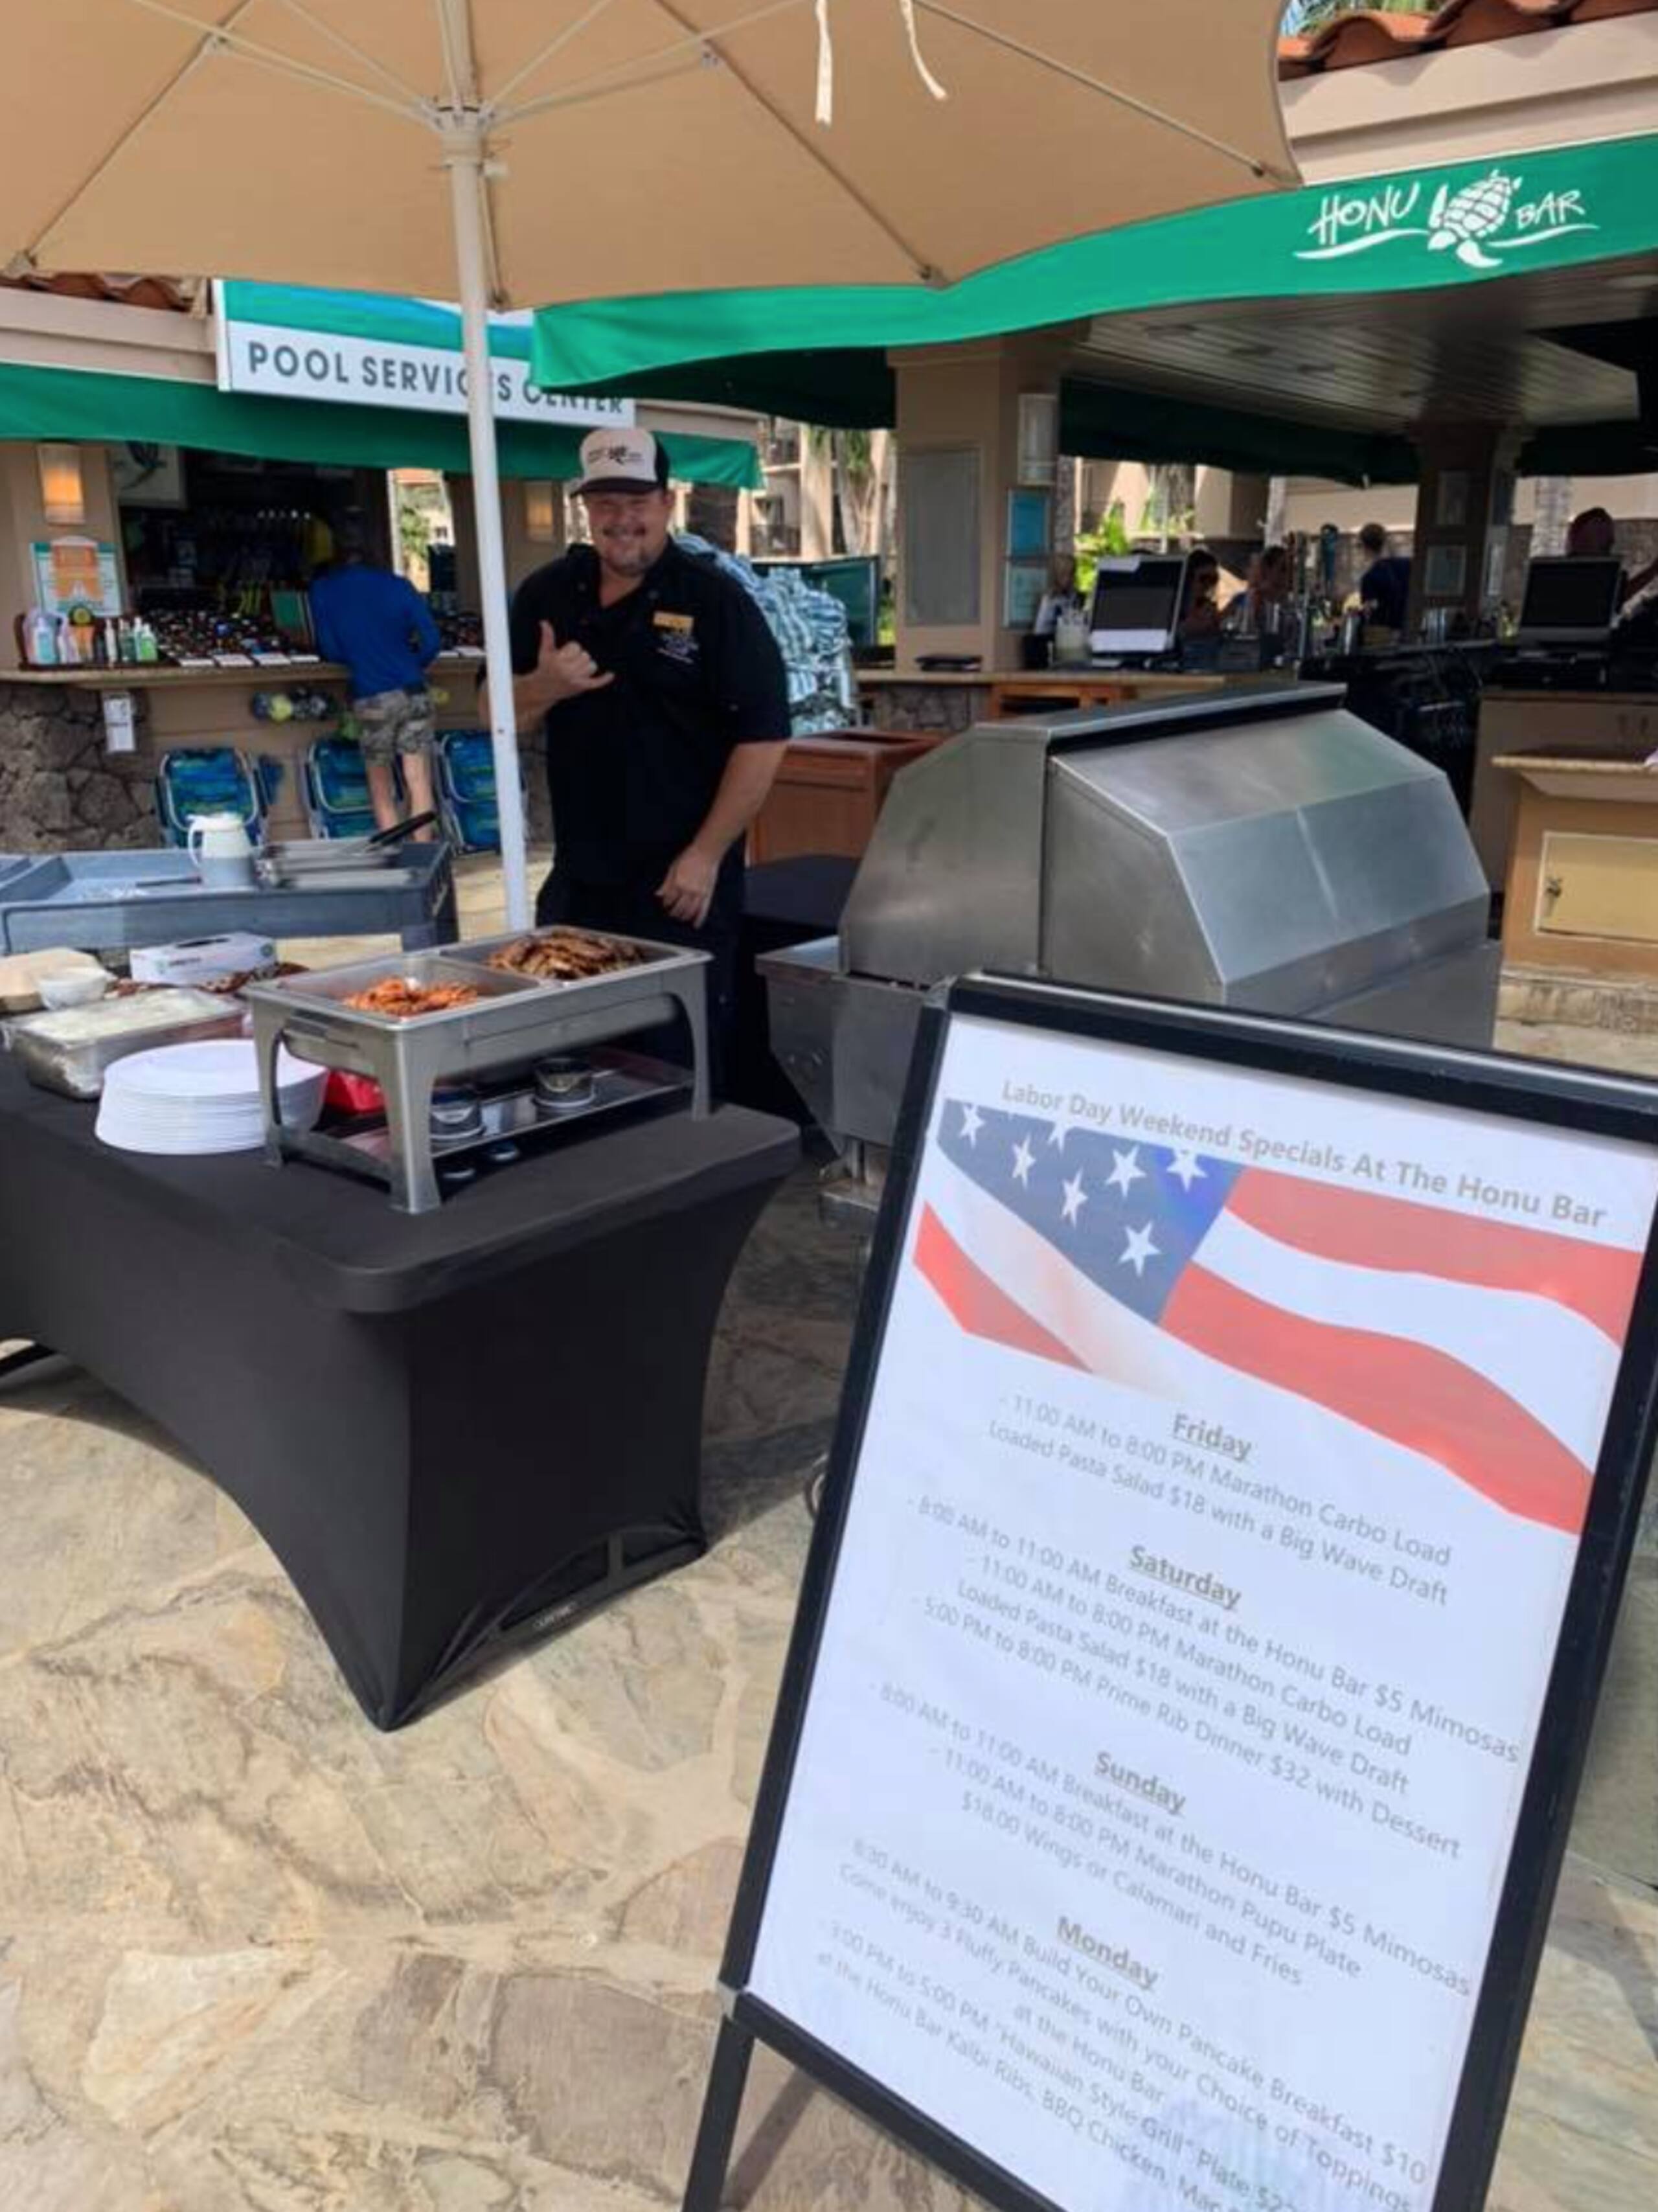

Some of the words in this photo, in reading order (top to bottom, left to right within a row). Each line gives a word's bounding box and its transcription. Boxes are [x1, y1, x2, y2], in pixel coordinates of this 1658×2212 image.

[1308, 182, 1420, 245] HONU
[1516, 190, 1585, 229] BAR
[249, 341, 348, 383] POOL
[361, 356, 511, 402] SERVICS
[1001, 1080, 1063, 1112] Labor
[1069, 1093, 1113, 1126] Day
[1120, 1102, 1231, 1147] Weekend
[1238, 1129, 1345, 1172] Specials
[1352, 1152, 1387, 1181] At
[1397, 1161, 1448, 1193] The
[1457, 1175, 1540, 1214] Honu
[1552, 1195, 1608, 1228] Bar
[988, 1419, 1054, 1458] Loaded
[1058, 1442, 1107, 1477] Pasta
[1112, 1463, 1164, 1500] Salad
[1169, 1485, 1205, 1515] $18
[1212, 1504, 1255, 1533] with
[1261, 1525, 1273, 1540] a
[1280, 1525, 1315, 1560] Big
[1321, 1538, 1383, 1580] Wave
[1389, 1566, 1448, 1606] Draft
[1062, 1414, 1096, 1440] AM
[1102, 1427, 1121, 1448] to
[1126, 1434, 1167, 1466] 8:00
[1171, 1451, 1205, 1480] PM
[1209, 1463, 1312, 1518] Marathon
[1318, 1503, 1387, 1544] Carbo
[1394, 1529, 1451, 1567] Load
[1172, 1413, 1253, 1462] Friday
[957, 1514, 988, 1540] AM
[992, 1527, 1010, 1550] to
[1017, 1536, 1064, 1571] 11:00
[1067, 1560, 1101, 1588] AM
[1106, 1573, 1194, 1626] Breakfast
[1198, 1615, 1220, 1637] at
[1225, 1623, 1258, 1654] the
[1264, 1638, 1324, 1682] Honu
[1331, 1665, 1368, 1700] Bar
[1374, 1683, 1403, 1714] $5
[1410, 1700, 1519, 1764] Mimosas
[1129, 1545, 1242, 1610] Saturday
[957, 1579, 1021, 1621] Loaded
[1025, 1610, 1073, 1645] Pasta
[1078, 1630, 1130, 1670] Salad
[1136, 1656, 1170, 1687] $18
[1175, 1678, 1219, 1710] with
[1223, 1700, 1236, 1717] a
[1242, 1704, 1277, 1740] Big
[1283, 1722, 1344, 1766] Wave
[1350, 1751, 1409, 1796] Draft
[963, 1614, 992, 1642] PM
[995, 1630, 1014, 1652] to
[1017, 1640, 1056, 1671] 8:00
[1060, 1659, 1092, 1686] PM
[1096, 1676, 1151, 1716] Prime
[1157, 1702, 1189, 1733] Rib
[1194, 1720, 1263, 1767] Dinner
[1269, 1754, 1311, 1790] $32
[1316, 1780, 1364, 1814] with
[1371, 1801, 1460, 1860] Dessert
[1032, 1577, 1064, 1606] AM
[1069, 1594, 1087, 1617] to
[1092, 1604, 1133, 1635] 8:00
[1137, 1622, 1171, 1649] PM
[1175, 1638, 1275, 1696] Marathon
[1280, 1683, 1347, 1728] Carbo
[1354, 1716, 1412, 1757] Load
[918, 1702, 949, 1729] AM
[952, 1720, 970, 1742] to
[1026, 1757, 1059, 1786] AM
[1063, 1773, 1150, 1834] Breakfast
[1155, 1822, 1175, 1845] at
[1180, 1832, 1214, 1863] the
[1220, 1851, 1278, 1898] Honu
[1284, 1884, 1321, 1919] Bar
[1329, 1905, 1356, 1935] $5
[1363, 1923, 1470, 1996] Mimosas
[1095, 1750, 1187, 1818] Sunday
[992, 1775, 1025, 1802] AM
[1030, 1792, 1049, 1816] to
[1099, 1827, 1130, 1858] PM
[1135, 1845, 1235, 1913] Marathon
[1241, 1900, 1297, 1944] Pupu
[1304, 1932, 1361, 1978] Plate
[1025, 1823, 1083, 1869] Wings
[1086, 1858, 1107, 1880] or
[1113, 1870, 1200, 1931] Calamari
[1205, 1923, 1246, 1955] and
[1251, 1944, 1302, 1986] Fries
[1057, 1915, 1159, 1990] Monday
[867, 1978, 911, 2019] Honu
[1041, 2088, 1084, 2133] BBQ
[892, 1860, 921, 1887] AM
[925, 1878, 942, 1902] to
[988, 1915, 1019, 1944] AM
[1023, 1934, 1071, 1975] Build
[1076, 1964, 1120, 2003] Your
[1125, 1994, 1173, 2035] Own
[1179, 2023, 1264, 2088] Pancake
[1270, 2077, 1373, 2155] Breakfast
[1381, 2142, 1425, 2185] $10
[959, 2000, 989, 2031] PM
[1089, 2082, 1138, 2126] Style
[1198, 2148, 1249, 2196] Plate
[1008, 1960, 1091, 2025] Pancakes
[1097, 2017, 1139, 2052] with
[1143, 2046, 1190, 2081] your
[1196, 2073, 1267, 2130] Choice
[1275, 2125, 1300, 2148] of
[1304, 2134, 1411, 2212] Toppings
[1014, 2005, 1032, 2025] at
[1038, 2016, 1067, 2044] the
[1073, 2036, 1125, 2082] Honu
[1131, 2071, 1166, 2104] Bar
